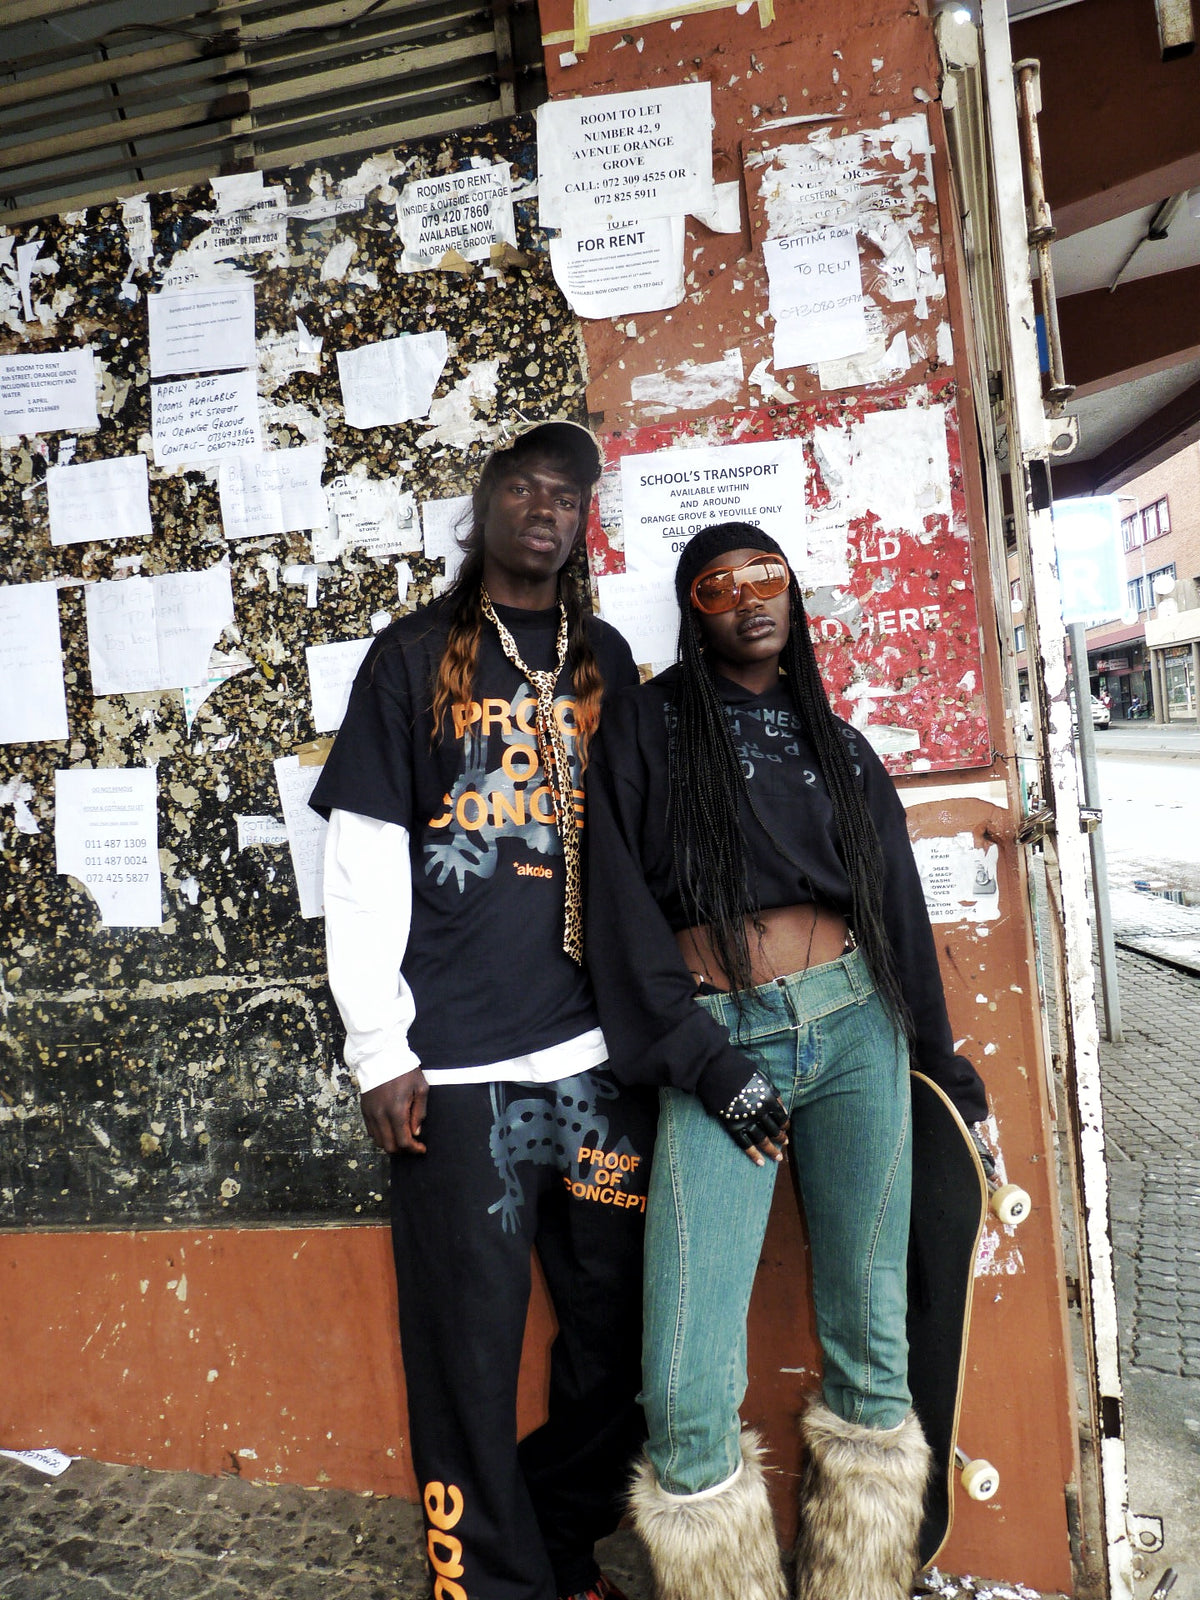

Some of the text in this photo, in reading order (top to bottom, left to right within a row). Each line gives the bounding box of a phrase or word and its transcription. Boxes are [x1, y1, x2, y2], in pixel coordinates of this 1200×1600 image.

[580, 104, 663, 126] ROOM TO LET
[583, 127, 635, 143] NUMBER
[654, 122, 661, 133] 9
[572, 136, 674, 160] AVENUE ORANGE
[602, 156, 645, 171] GROVE
[417, 173, 492, 198] ROOMS TO RENT
[564, 168, 687, 194] CALL: 072 309 4525 OR
[334, 198, 364, 213] RENT
[402, 187, 508, 216] INSIDE & OUTSIDE COTTAGE
[594, 188, 657, 205] 072 825 5911
[421, 204, 489, 229] 079 420 7860
[248, 234, 262, 244] JULY
[262, 233, 278, 243] 2024
[419, 228, 468, 244] AVAILABLE
[577, 231, 646, 253] FOR RENT
[419, 235, 497, 257] IN ORANGE GROOVE
[794, 260, 852, 276] TO RENT
[31, 380, 64, 388] ELECTRICITY
[34, 371, 58, 379] ORANGE
[195, 378, 219, 391] 2025
[157, 391, 239, 413] ROOMS AVAILABLE
[156, 413, 184, 426] ALONG
[205, 405, 239, 417] STREET
[157, 416, 245, 439] IN ORANGE GROOVE
[640, 463, 779, 487] SCHOOL'S TRANSPORT
[670, 483, 750, 498] AVAILABLE WITHIN
[680, 496, 741, 509] AND AROUND
[640, 505, 783, 525] ORANGE GROVE & YEOVILLE ONLY
[662, 525, 686, 538] CALL
[687, 524, 702, 535] OR
[671, 541, 685, 553] 08
[860, 605, 942, 637] HERE
[85, 839, 147, 849] 011 487 1309
[85, 856, 148, 865] 011 487 0024
[86, 873, 150, 883] 072 425 5827
[577, 1147, 641, 1173] PROOF
[594, 1169, 623, 1187] OF
[563, 1177, 648, 1213] CONCEPT
